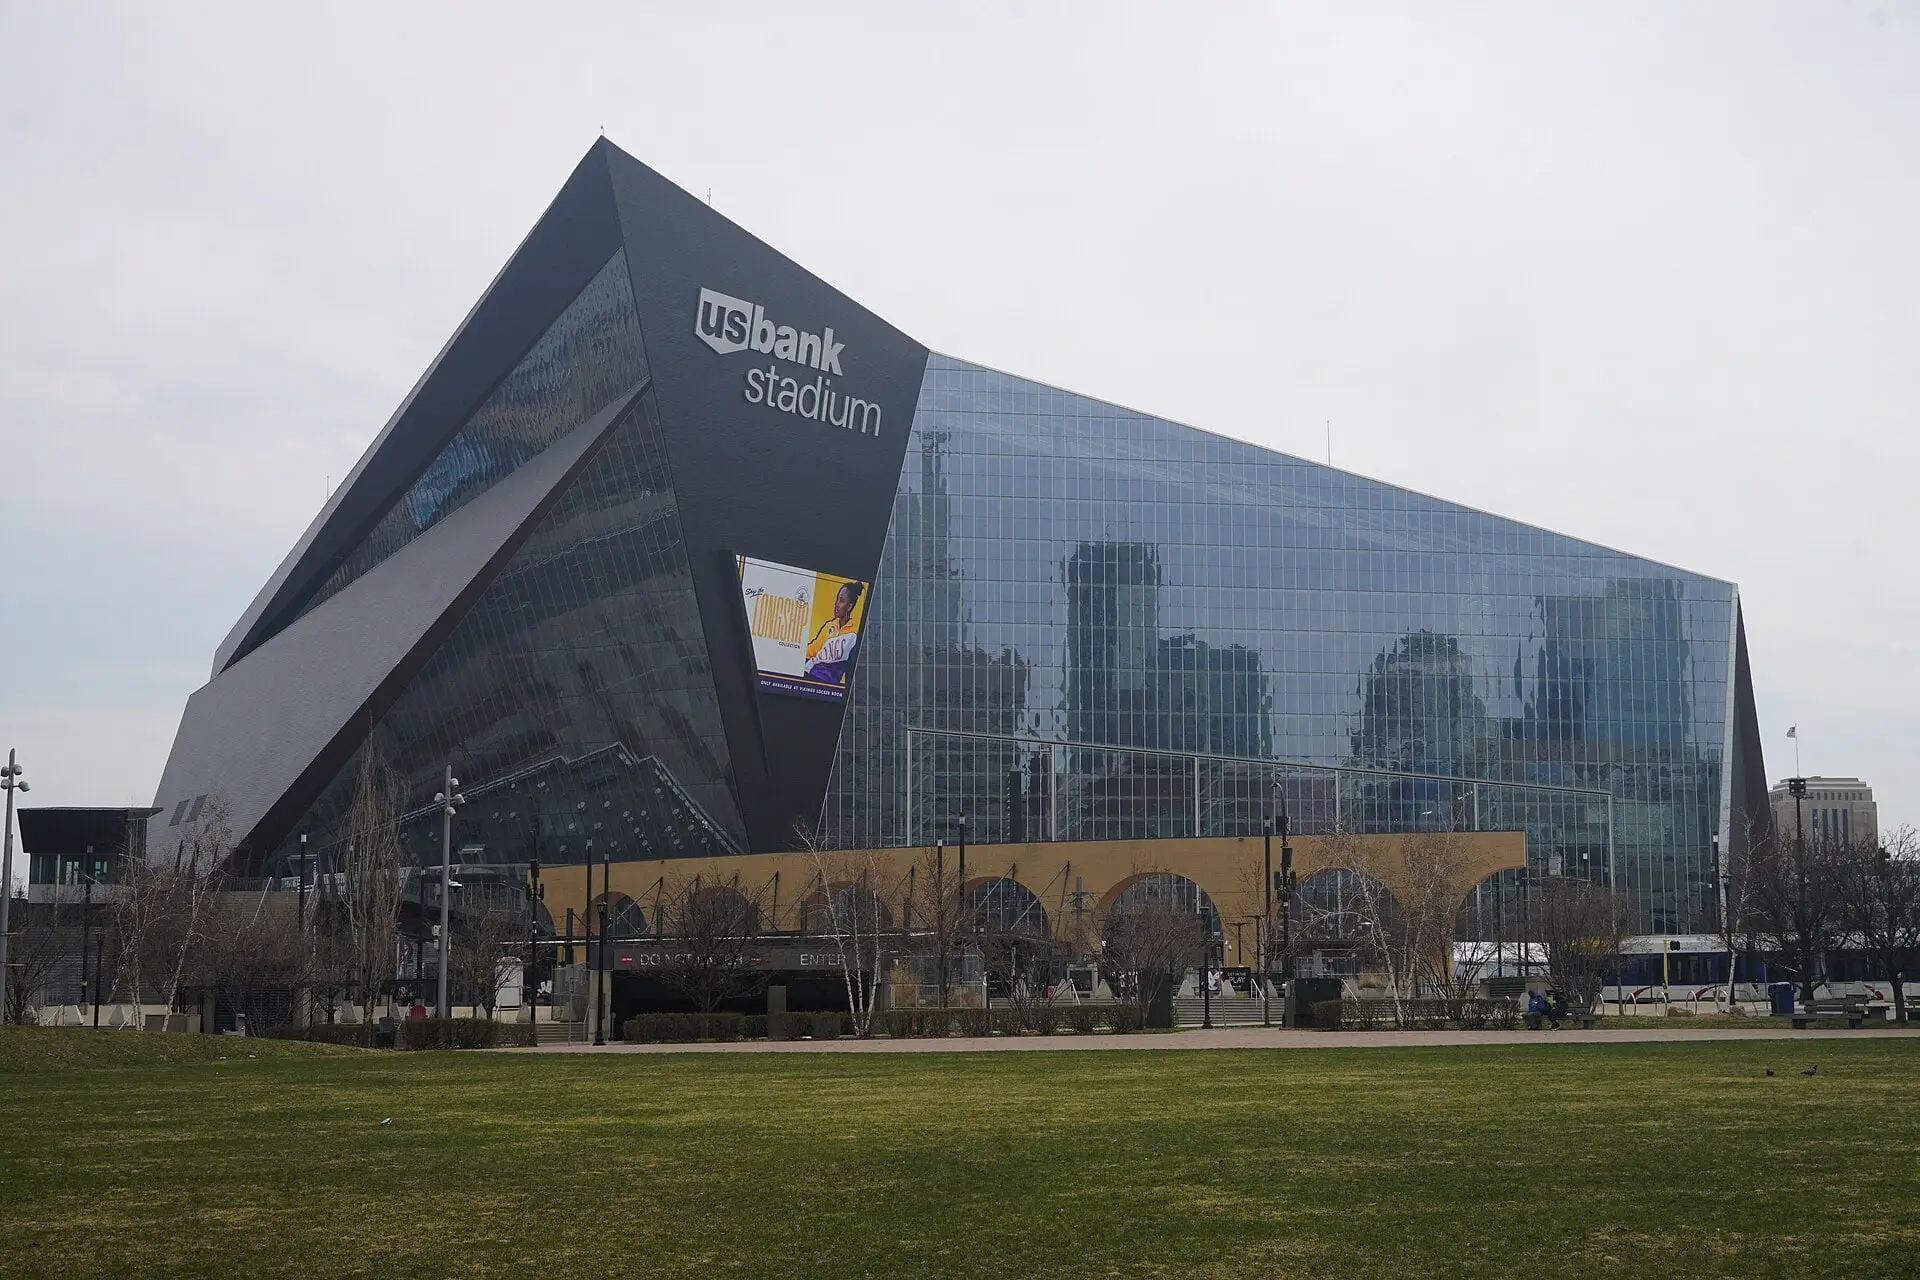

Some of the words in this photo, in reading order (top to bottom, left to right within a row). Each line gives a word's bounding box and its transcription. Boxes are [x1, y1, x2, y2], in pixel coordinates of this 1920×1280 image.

[744, 365, 881, 437] stadium
[752, 594, 809, 644] LONGSHIP
[640, 953, 660, 966] DO
[697, 953, 743, 966] ENER
[800, 954, 846, 966] ENTER
[1229, 976, 1245, 984] PLAY
